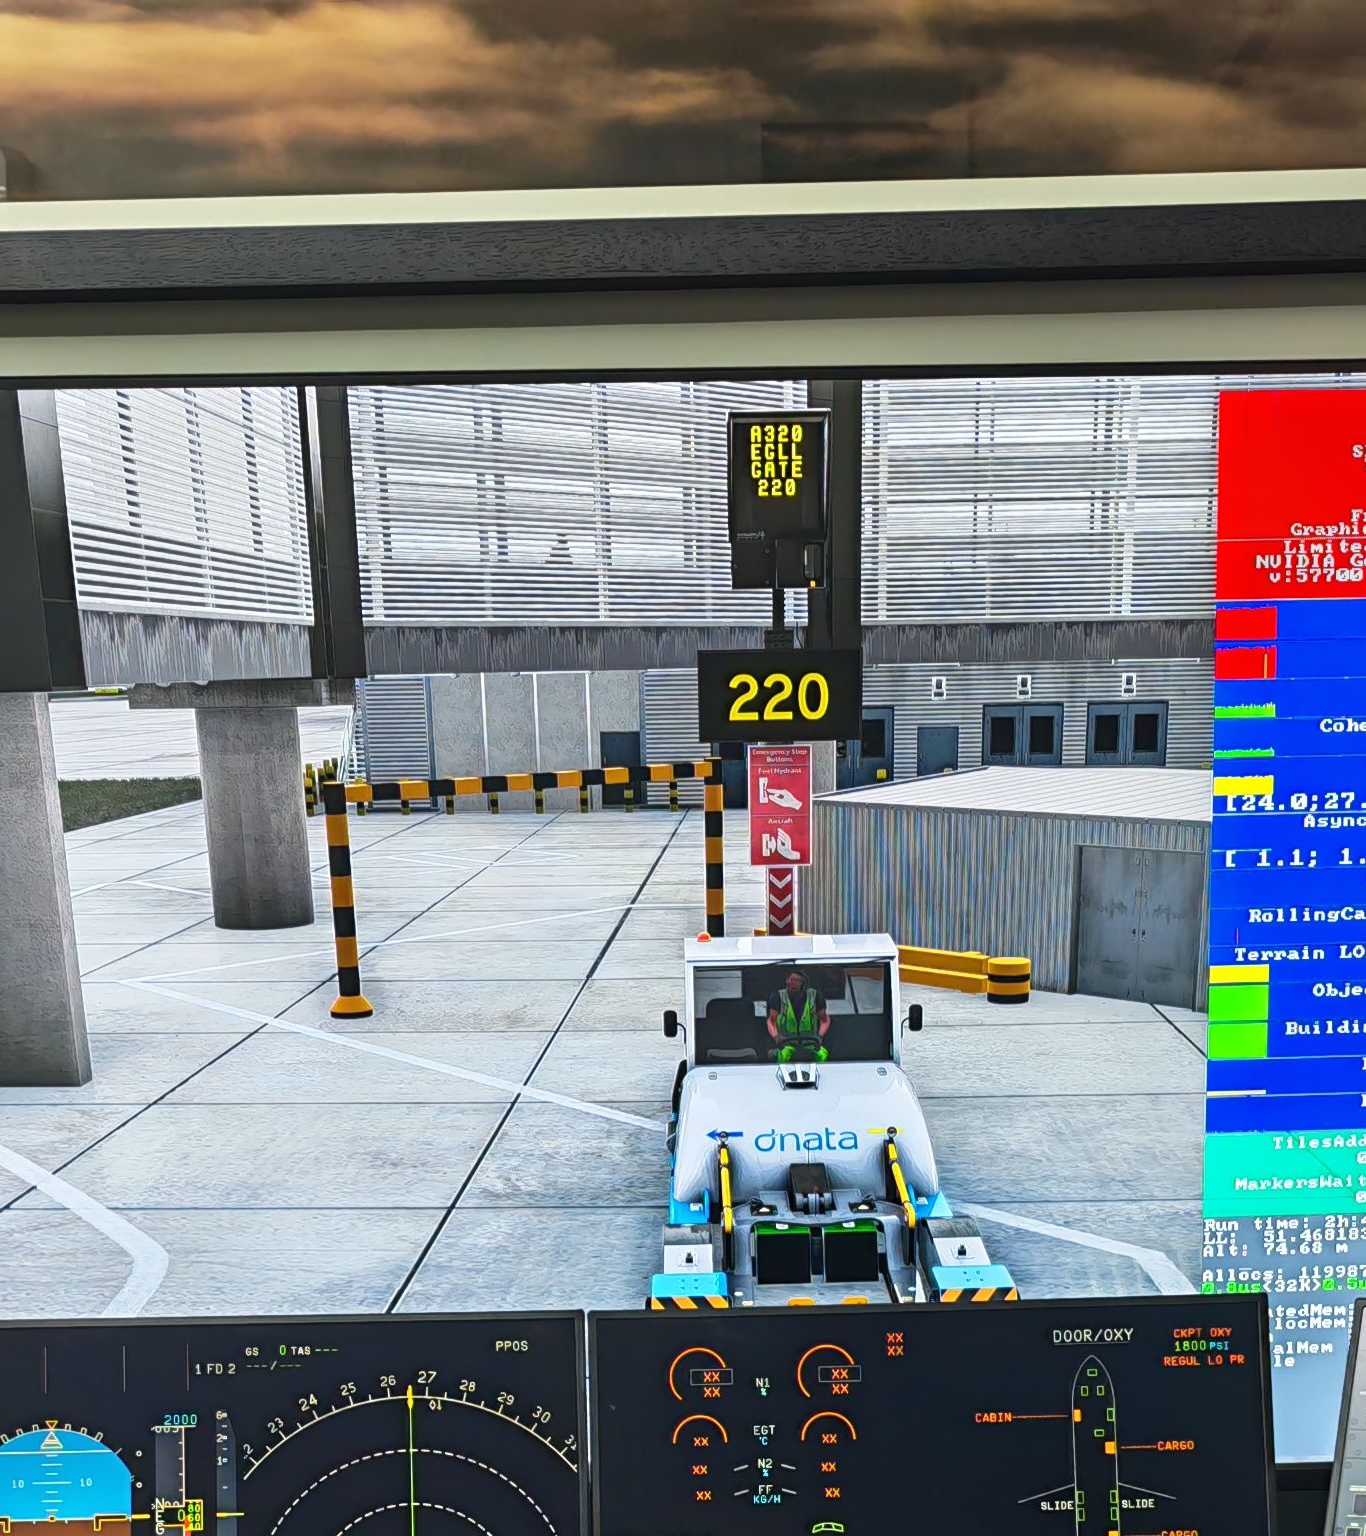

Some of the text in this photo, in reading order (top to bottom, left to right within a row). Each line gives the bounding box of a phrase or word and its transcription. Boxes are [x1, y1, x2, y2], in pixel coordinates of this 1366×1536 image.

[750, 424, 804, 443] A320
[750, 443, 803, 462] EGLL
[751, 461, 803, 479] GATE
[758, 479, 796, 497] 220
[1255, 555, 1335, 569] NVIDIA
[1269, 568, 1363, 583] v:57700
[728, 672, 830, 723] 220
[1235, 945, 1325, 962] Terrain
[754, 1126, 859, 1152] dnata
[1204, 1219, 1239, 1232] Run
[1253, 1216, 1310, 1230] time:
[1203, 1241, 1348, 1259] Alt: 74.68 m
[1053, 1329, 1133, 1343] DOOR/OXY
[1173, 1328, 1232, 1338] CKPT OXY
[495, 1341, 528, 1351] PPOS
[1174, 1340, 1229, 1351] 1800 PSI
[245, 1347, 311, 1356] GS TAS
[1163, 1355, 1245, 1366] REGUL LO PR
[207, 1364, 223, 1374] FD
[756, 1377, 770, 1388] N1
[163, 1414, 197, 1426] 2000
[975, 1413, 1012, 1423] CABIN
[753, 1425, 775, 1435] EGT
[1157, 1441, 1195, 1451] CARGO
[757, 1459, 772, 1469] N2
[758, 1485, 773, 1495] FF
[753, 1494, 780, 1504] KG/H
[1121, 1499, 1155, 1508] SLIDE
[1040, 1501, 1074, 1510] SLIDE
